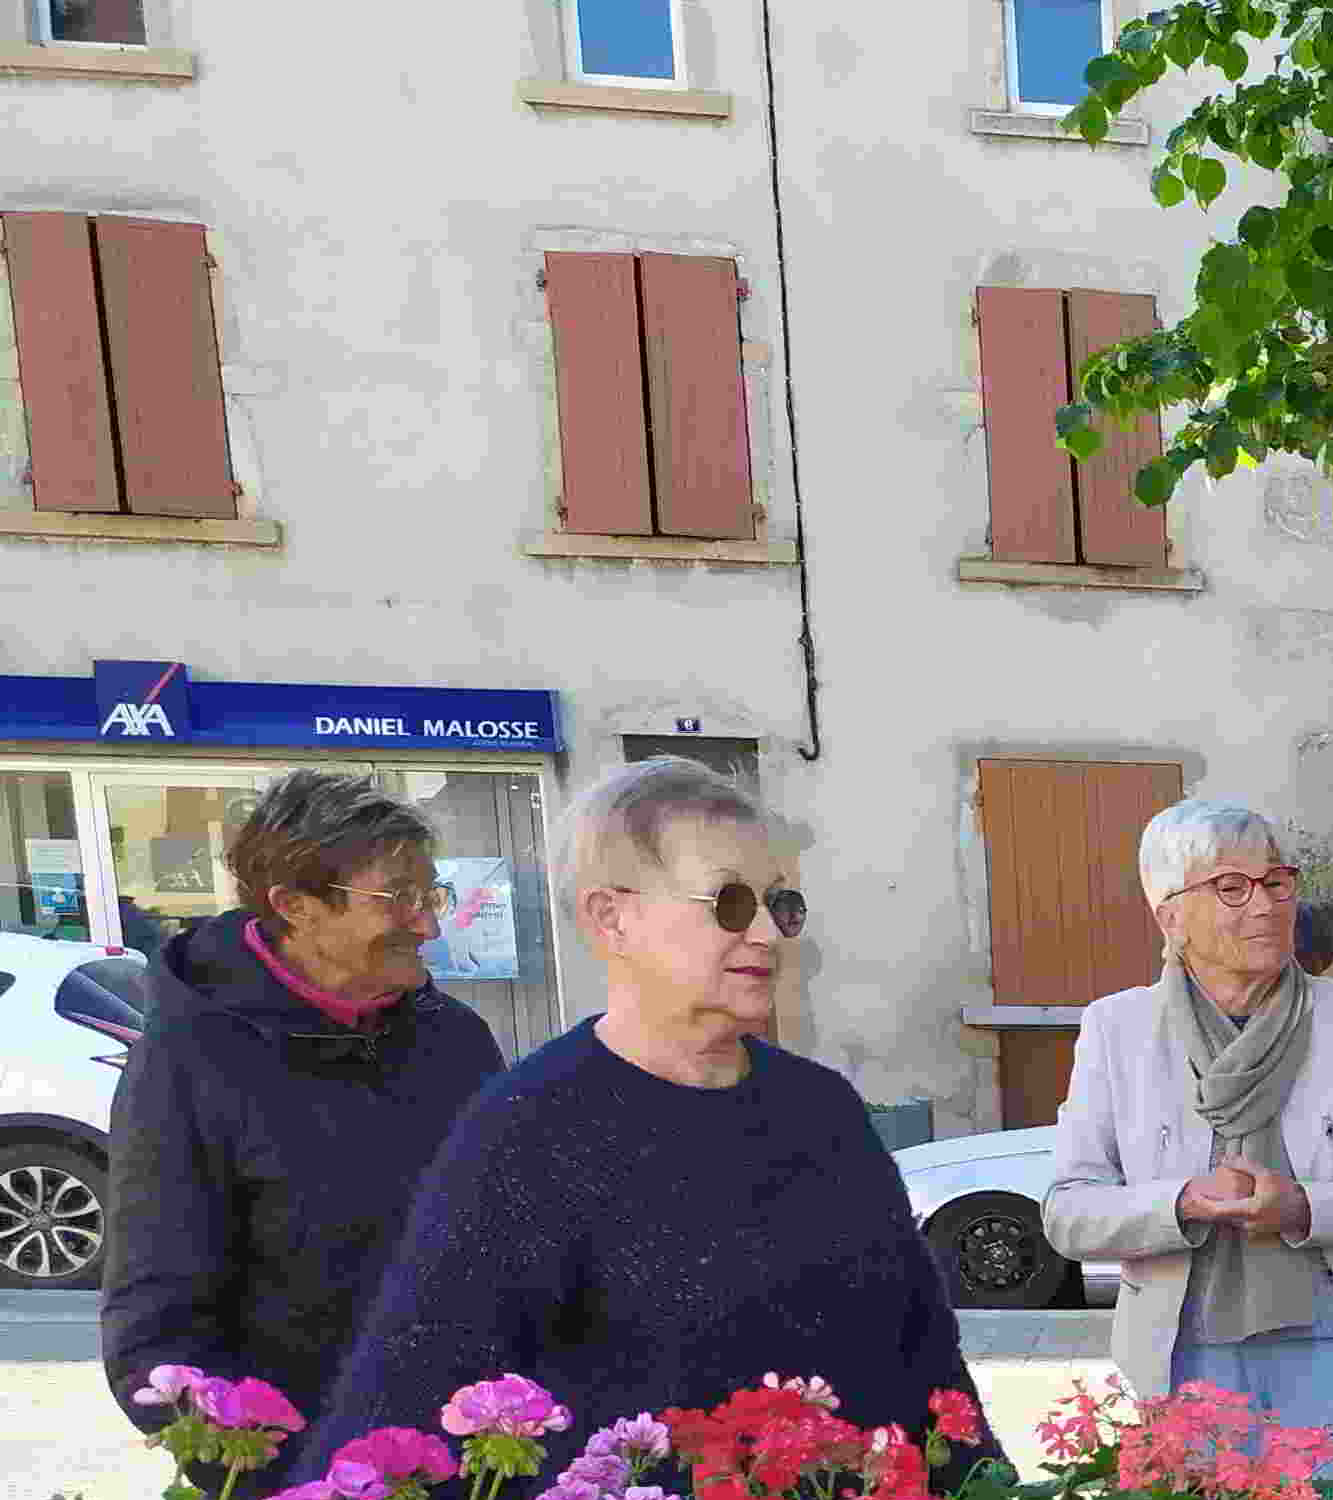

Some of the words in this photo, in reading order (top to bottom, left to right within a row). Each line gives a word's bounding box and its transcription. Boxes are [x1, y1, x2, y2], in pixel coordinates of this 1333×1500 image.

[102, 703, 175, 736] AXA
[315, 716, 411, 737] DANIEL
[423, 719, 539, 739] MALOSSE
